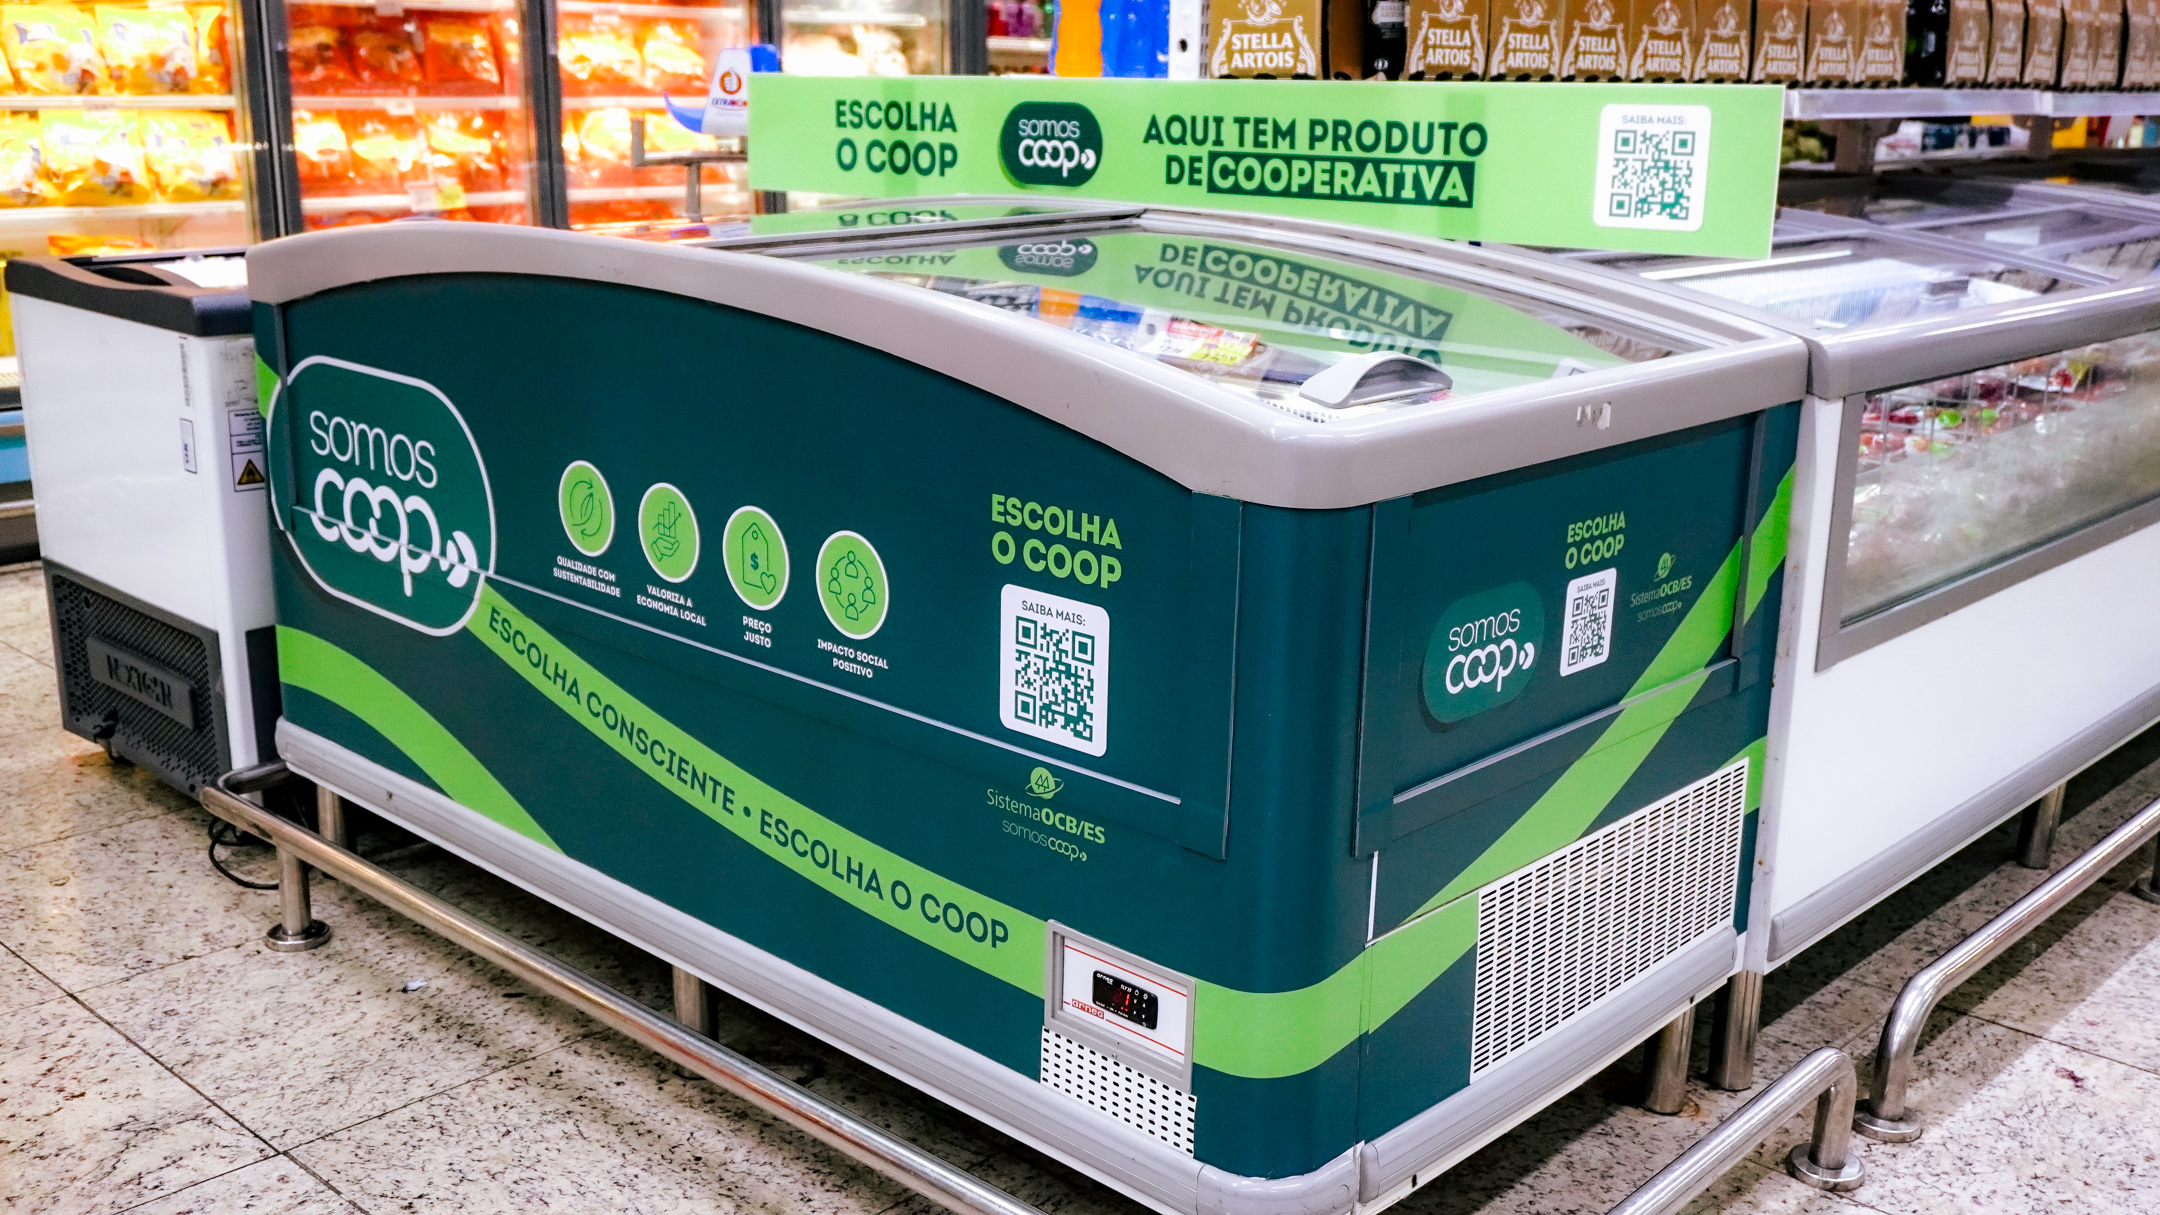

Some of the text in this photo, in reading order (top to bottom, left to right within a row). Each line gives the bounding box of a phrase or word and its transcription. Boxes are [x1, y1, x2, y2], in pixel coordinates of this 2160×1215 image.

[1231, 32, 1294, 49] STELLA
[1427, 28, 1470, 47] STELLA
[1508, 33, 1549, 50] STELLA
[1579, 36, 1616, 52] STELLA
[1648, 40, 1682, 55] STELLA
[1709, 42, 1740, 57] STELLA
[1231, 52, 1294, 68] ARTOIS
[1426, 48, 1471, 66] ARTOIS
[1506, 52, 1549, 68] ARTOIS
[1577, 53, 1615, 70] ARTOIS
[1646, 57, 1681, 72] ARTOIS
[835, 99, 957, 132] ESCOLHA
[1018, 117, 1080, 138] somos
[1622, 115, 1687, 125] SAIBA MAIS:
[1143, 114, 1488, 157] AQUI TEM PRODUTO
[836, 137, 957, 177] O COOP
[1018, 138, 1080, 178] coop
[1165, 154, 1469, 203] DE COOPERATIVA
[310, 410, 438, 488] somos
[310, 468, 441, 597] coop
[992, 493, 1122, 550] ESCOLHA
[1567, 511, 1626, 543] ESCOLHA
[992, 531, 1122, 589] O COOP
[1565, 534, 1625, 569] O COOP
[553, 567, 621, 597] SUSTENTABILIDADE
[557, 556, 616, 582] QUALIDADE COM
[646, 584, 693, 608] VALORIZA A
[1577, 578, 1606, 593] SAIBA MAIS:
[636, 595, 707, 626] ECONOMIA LOCAL
[1021, 600, 1086, 627] SAIBA MAIS:
[742, 615, 772, 634] PREÇO
[1448, 608, 1521, 652] somos
[743, 631, 772, 648] JUSTO
[817, 638, 889, 669] IMPACTO SOCIAL
[1445, 638, 1517, 695] coop
[832, 658, 873, 678] POSITIVO
[489, 606, 1009, 949] ESCOLHA CONSCIENTE ESCOLHA O COOP
[987, 788, 1106, 844] SistemaOCB/ES
